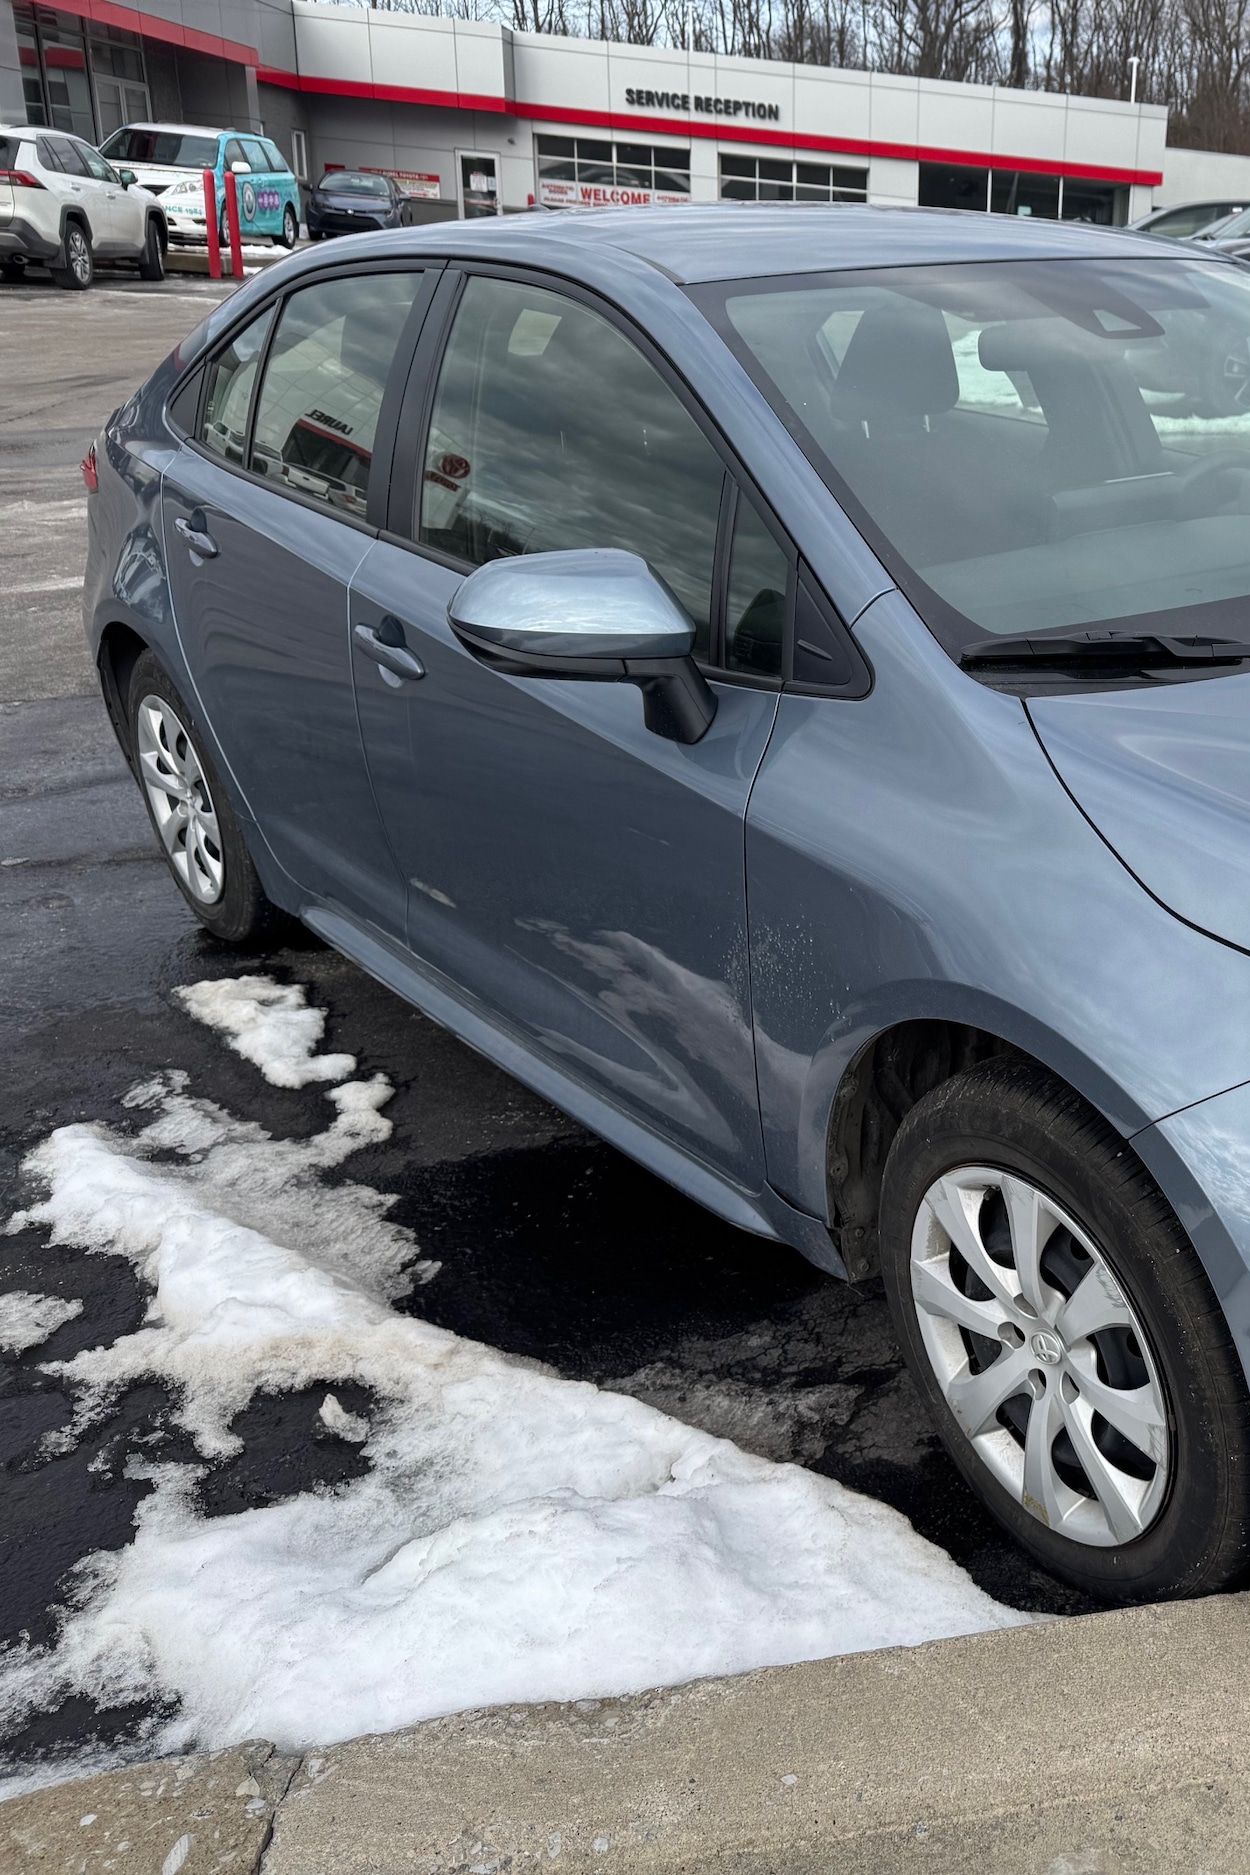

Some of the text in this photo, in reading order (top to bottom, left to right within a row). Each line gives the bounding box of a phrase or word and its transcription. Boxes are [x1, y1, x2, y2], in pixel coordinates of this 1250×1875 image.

[625, 88, 779, 121] SERVICE RECEPTION
[580, 186, 651, 205] WELCOME
[164, 205, 183, 213] NCE
